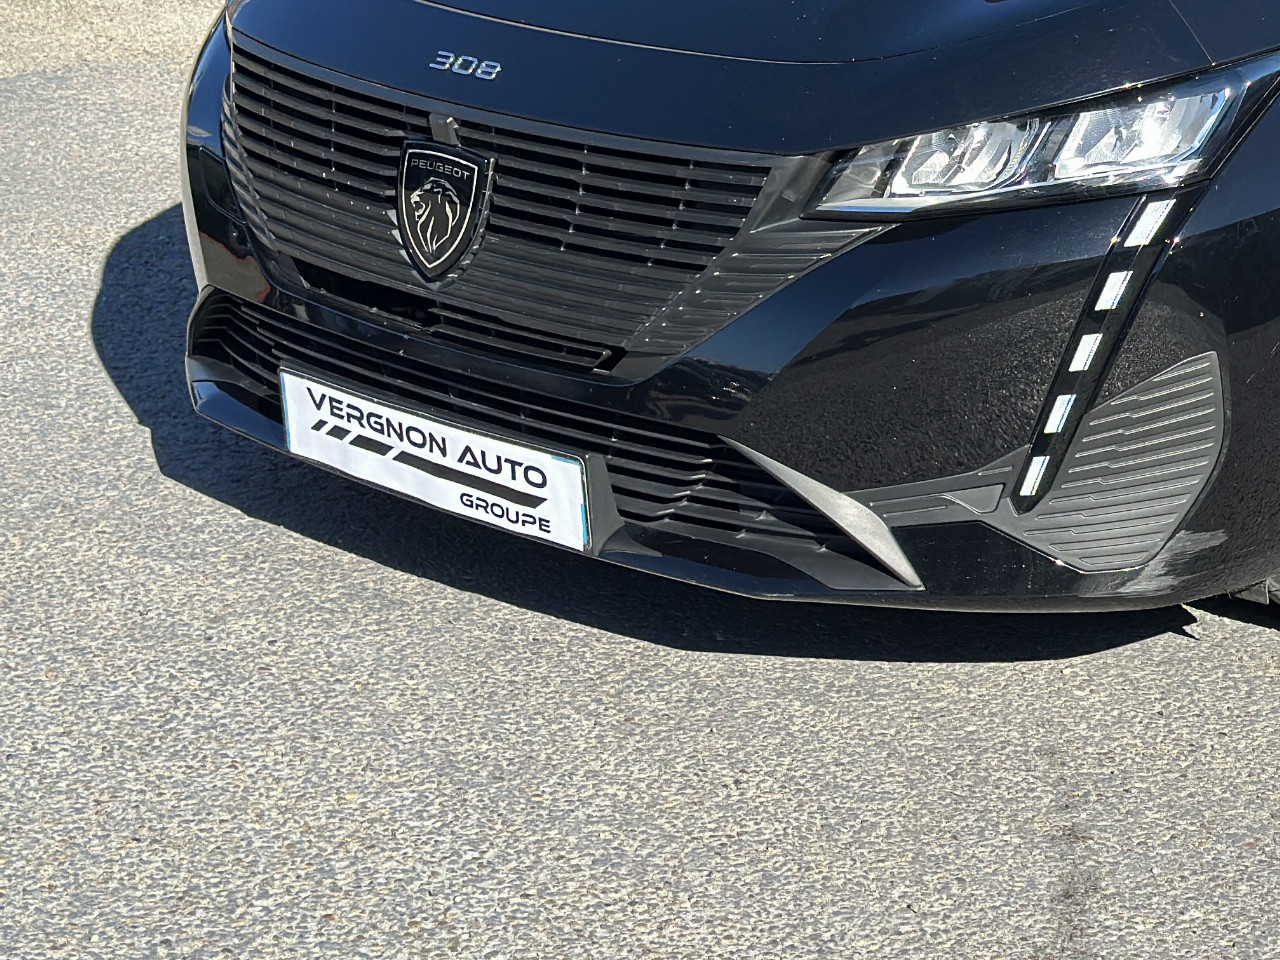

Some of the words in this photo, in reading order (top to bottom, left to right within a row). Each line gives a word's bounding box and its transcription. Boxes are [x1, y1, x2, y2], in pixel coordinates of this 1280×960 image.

[429, 50, 502, 80] 308
[410, 157, 471, 181] PEUGEOT
[305, 386, 448, 458] VERGNON
[456, 444, 548, 489] AUTO
[459, 492, 551, 534] GROUPE
